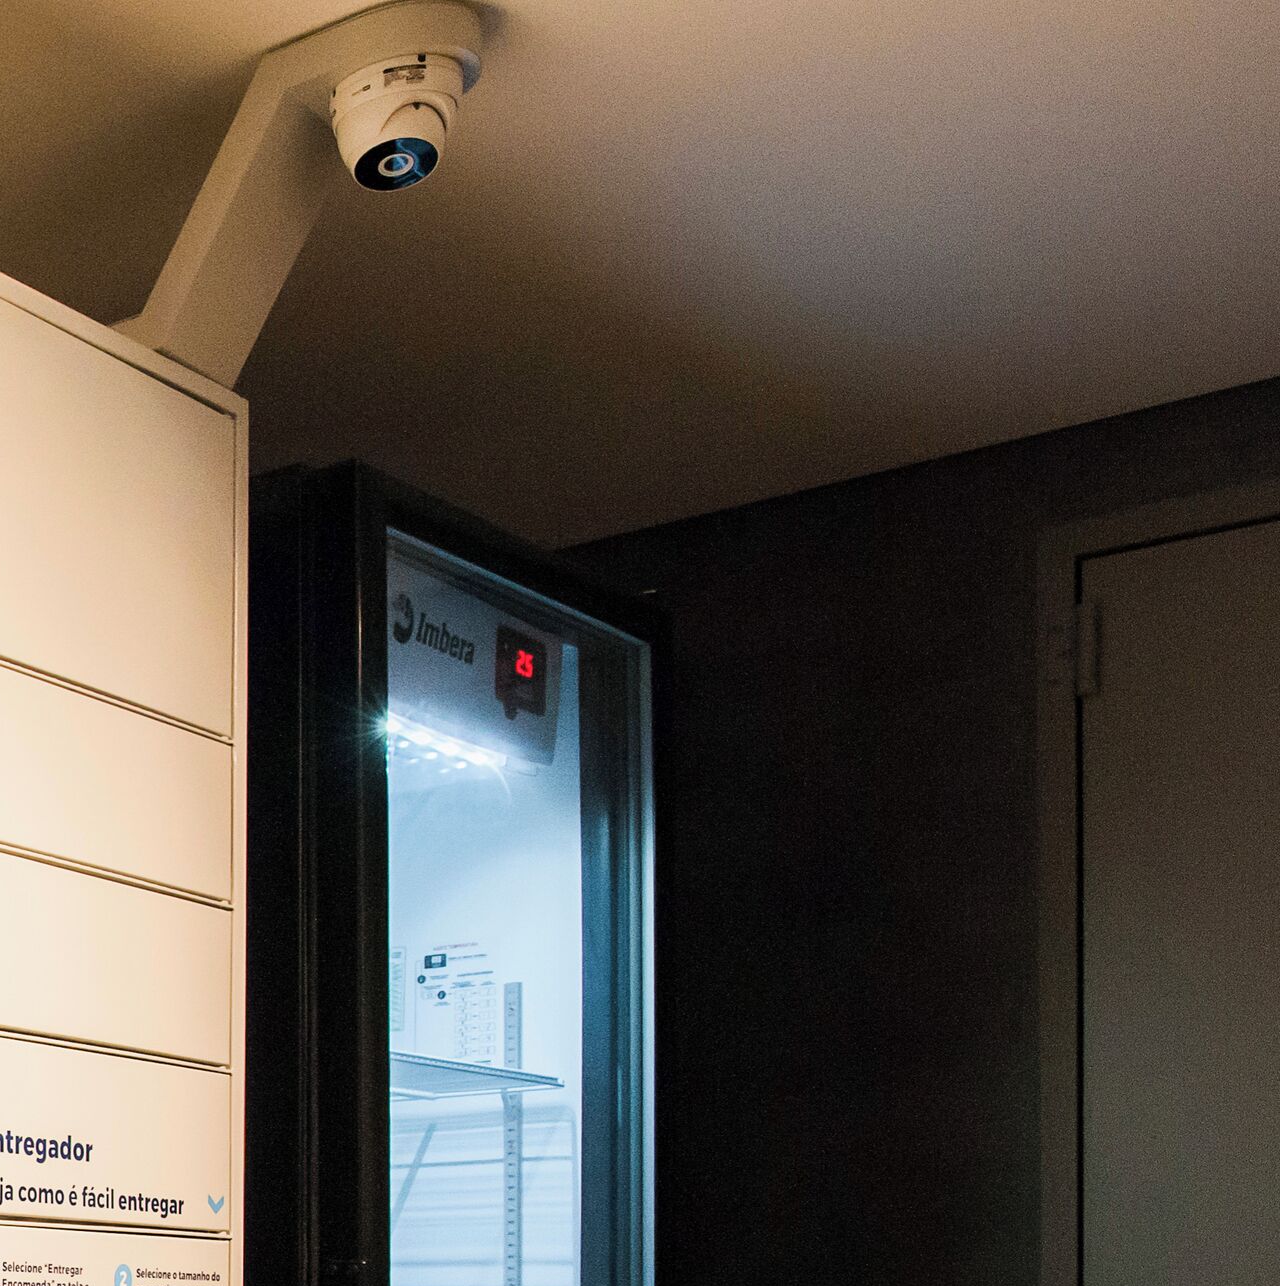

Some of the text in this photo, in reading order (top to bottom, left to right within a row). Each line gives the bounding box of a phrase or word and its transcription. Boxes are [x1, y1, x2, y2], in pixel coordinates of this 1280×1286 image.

[415, 612, 475, 665] Imbera
[18, 1185, 64, 1205] como
[69, 1185, 78, 1206] é
[82, 1186, 115, 1209] fácil
[118, 1192, 185, 1219] entregar
[2, 1261, 43, 1274] Selecione
[136, 1268, 221, 1282] Selecione o tamanho do
